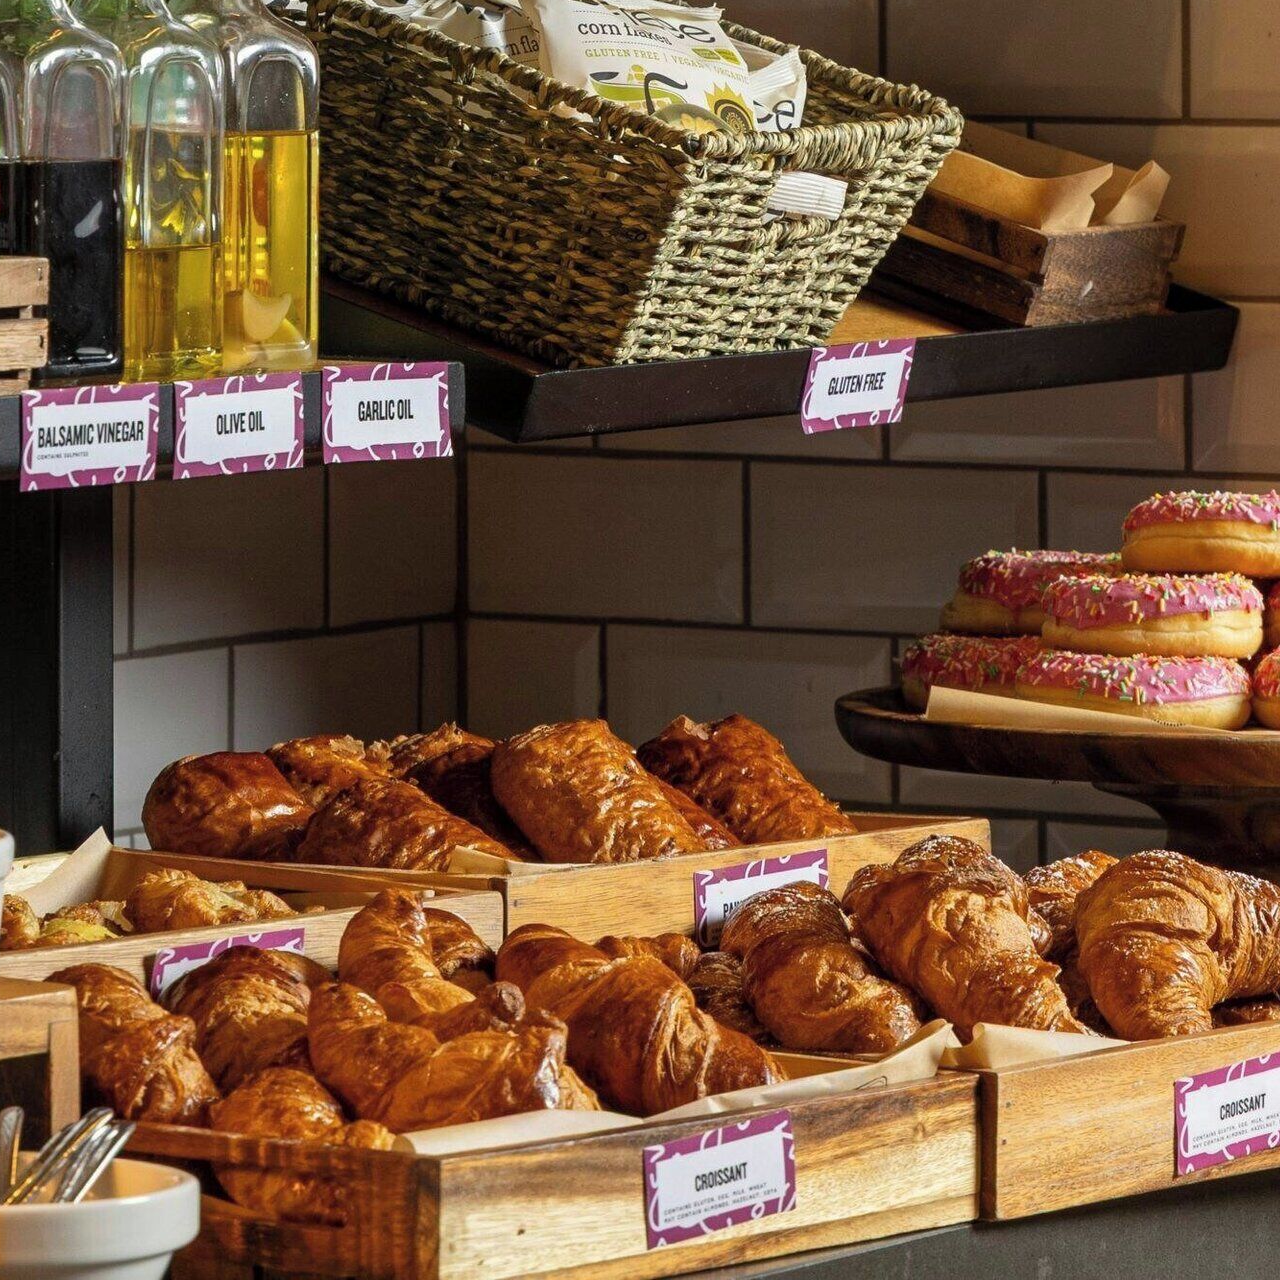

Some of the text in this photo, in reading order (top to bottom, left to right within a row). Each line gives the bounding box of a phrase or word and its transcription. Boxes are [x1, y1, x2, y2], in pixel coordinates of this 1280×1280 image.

[577, 20, 621, 37] corn
[522, 35, 540, 53] fla
[584, 48, 632, 59] GLUTEN
[633, 50, 660, 62] FREE
[827, 371, 888, 397] GLUTEN FREE
[215, 410, 266, 436] OLIVE OIL
[357, 399, 415, 422] GARLIC OIL
[37, 420, 145, 449] BALSAMIC VINEGAR
[1219, 1093, 1267, 1121] CROISSANT
[694, 1161, 748, 1193] CROISSANT
